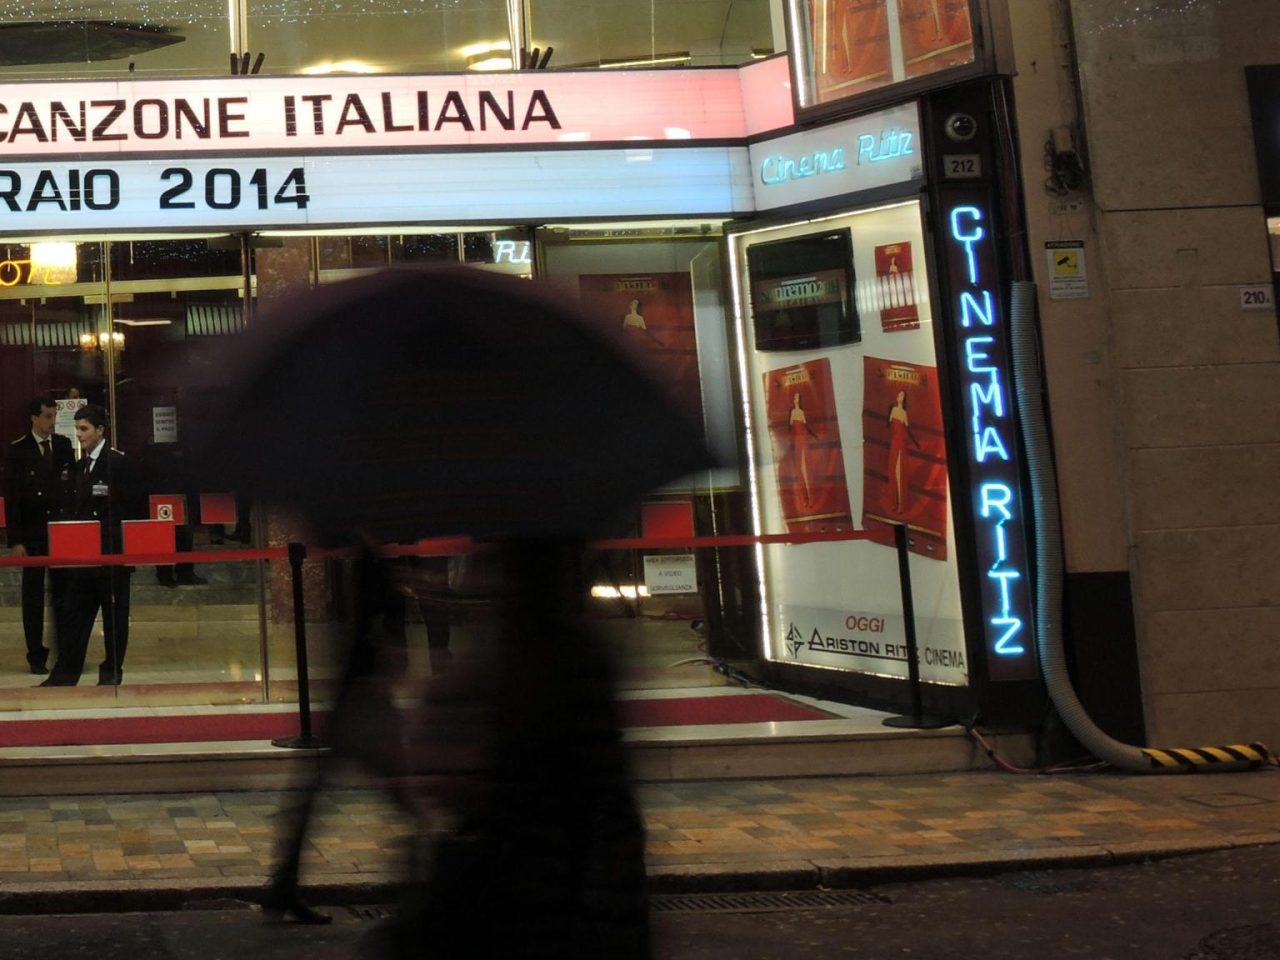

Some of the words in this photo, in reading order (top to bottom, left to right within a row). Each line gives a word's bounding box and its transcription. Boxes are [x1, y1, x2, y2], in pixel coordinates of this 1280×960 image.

[284, 88, 563, 137] ITALIANA
[760, 148, 846, 186] Cinema
[857, 127, 914, 167] Ritz
[951, 159, 975, 173] 212
[159, 166, 311, 211] 2014
[950, 206, 1009, 462] CINEMA
[980, 483, 1025, 655] RITZ
[845, 615, 885, 634] OGGI
[808, 627, 881, 656] ARISTON
[924, 647, 966, 669] CINEMA
